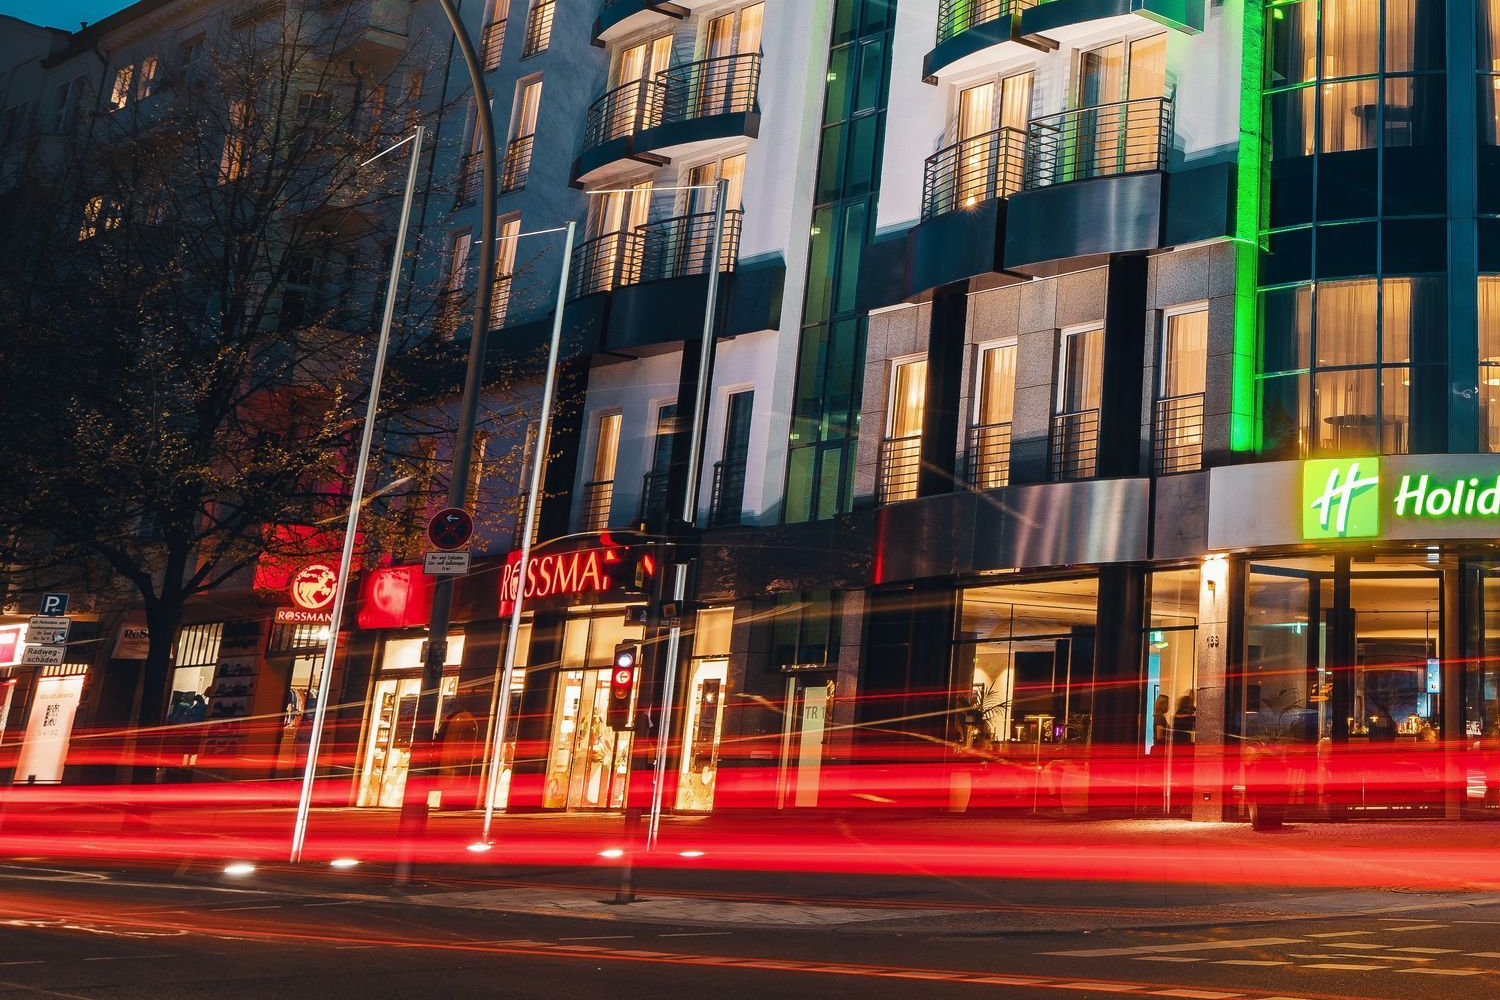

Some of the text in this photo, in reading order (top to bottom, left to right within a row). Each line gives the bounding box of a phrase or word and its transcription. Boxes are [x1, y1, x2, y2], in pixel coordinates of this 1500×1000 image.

[500, 550, 654, 601] ROSSMA
[278, 611, 334, 622] ROSSMAN
[27, 647, 61, 656] Radweg-
